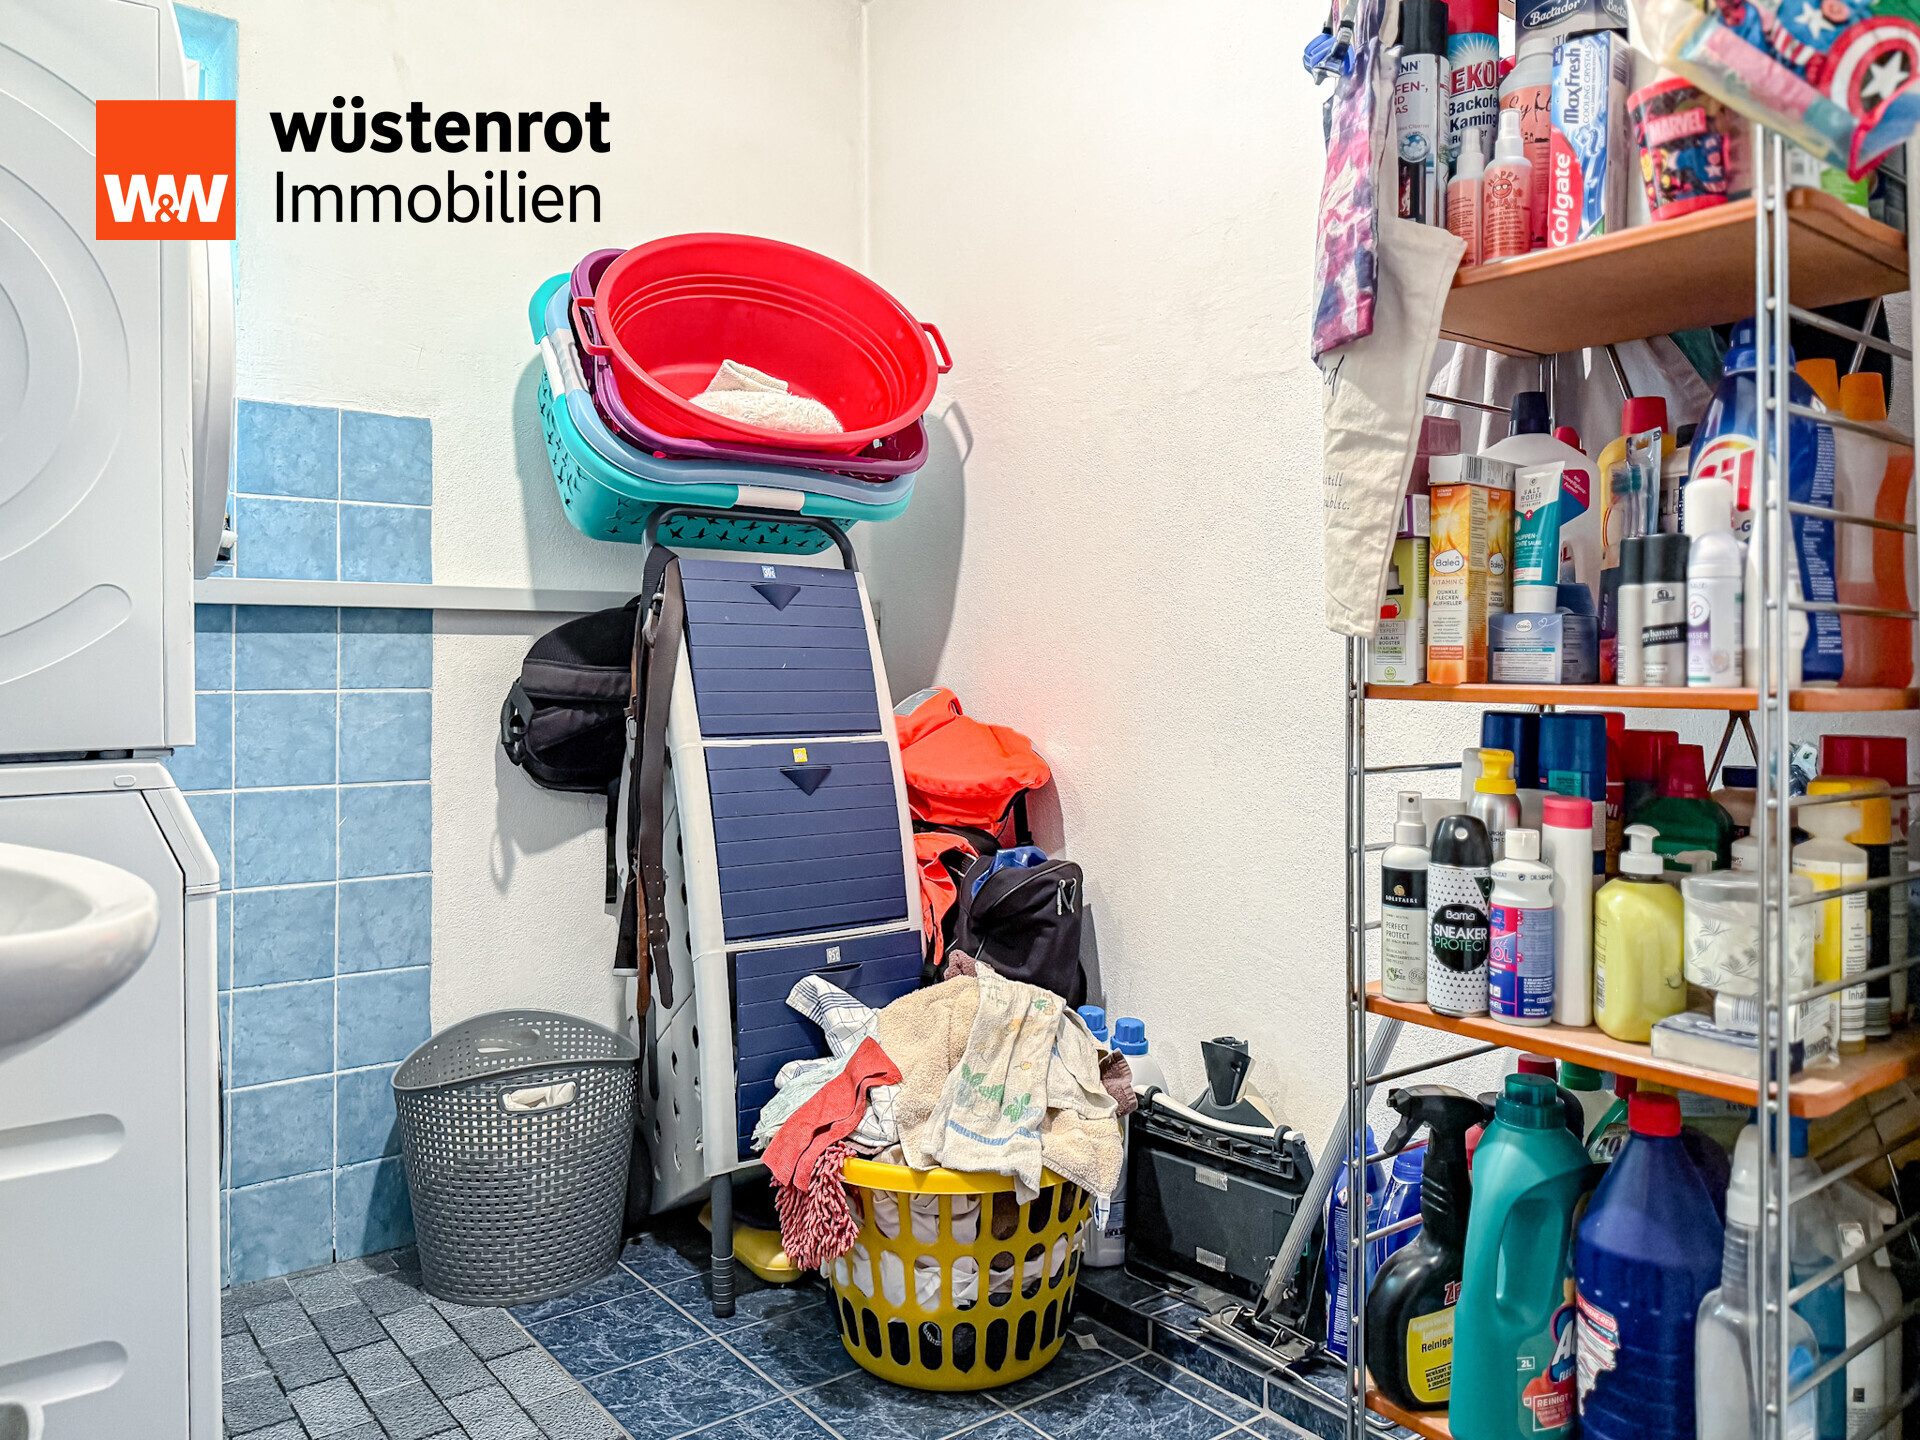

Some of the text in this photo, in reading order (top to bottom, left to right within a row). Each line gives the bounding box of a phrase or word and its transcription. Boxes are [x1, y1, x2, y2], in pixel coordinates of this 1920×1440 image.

[1529, 0, 1581, 26] Bactador
[1563, 47, 1582, 124] MaxFresh
[1582, 42, 1592, 124] COOLING CRYSTALS
[1448, 93, 1499, 117] Backofe
[1551, 152, 1574, 247] Colgate
[1435, 556, 1460, 567] Balea
[1385, 894, 1418, 904] SOLITAIRE
[1446, 909, 1475, 921] Bama
[1385, 921, 1408, 931] PERFECT
[1433, 923, 1488, 940] SNEAKER
[1385, 929, 1410, 939] PROTECT
[1434, 936, 1486, 952] PROTECT
[1848, 990, 1866, 1001] Inhal
[1421, 1336, 1454, 1354] Reinige
[1521, 1359, 1532, 1369] 2L
[1536, 1393, 1569, 1408] REINIGT
